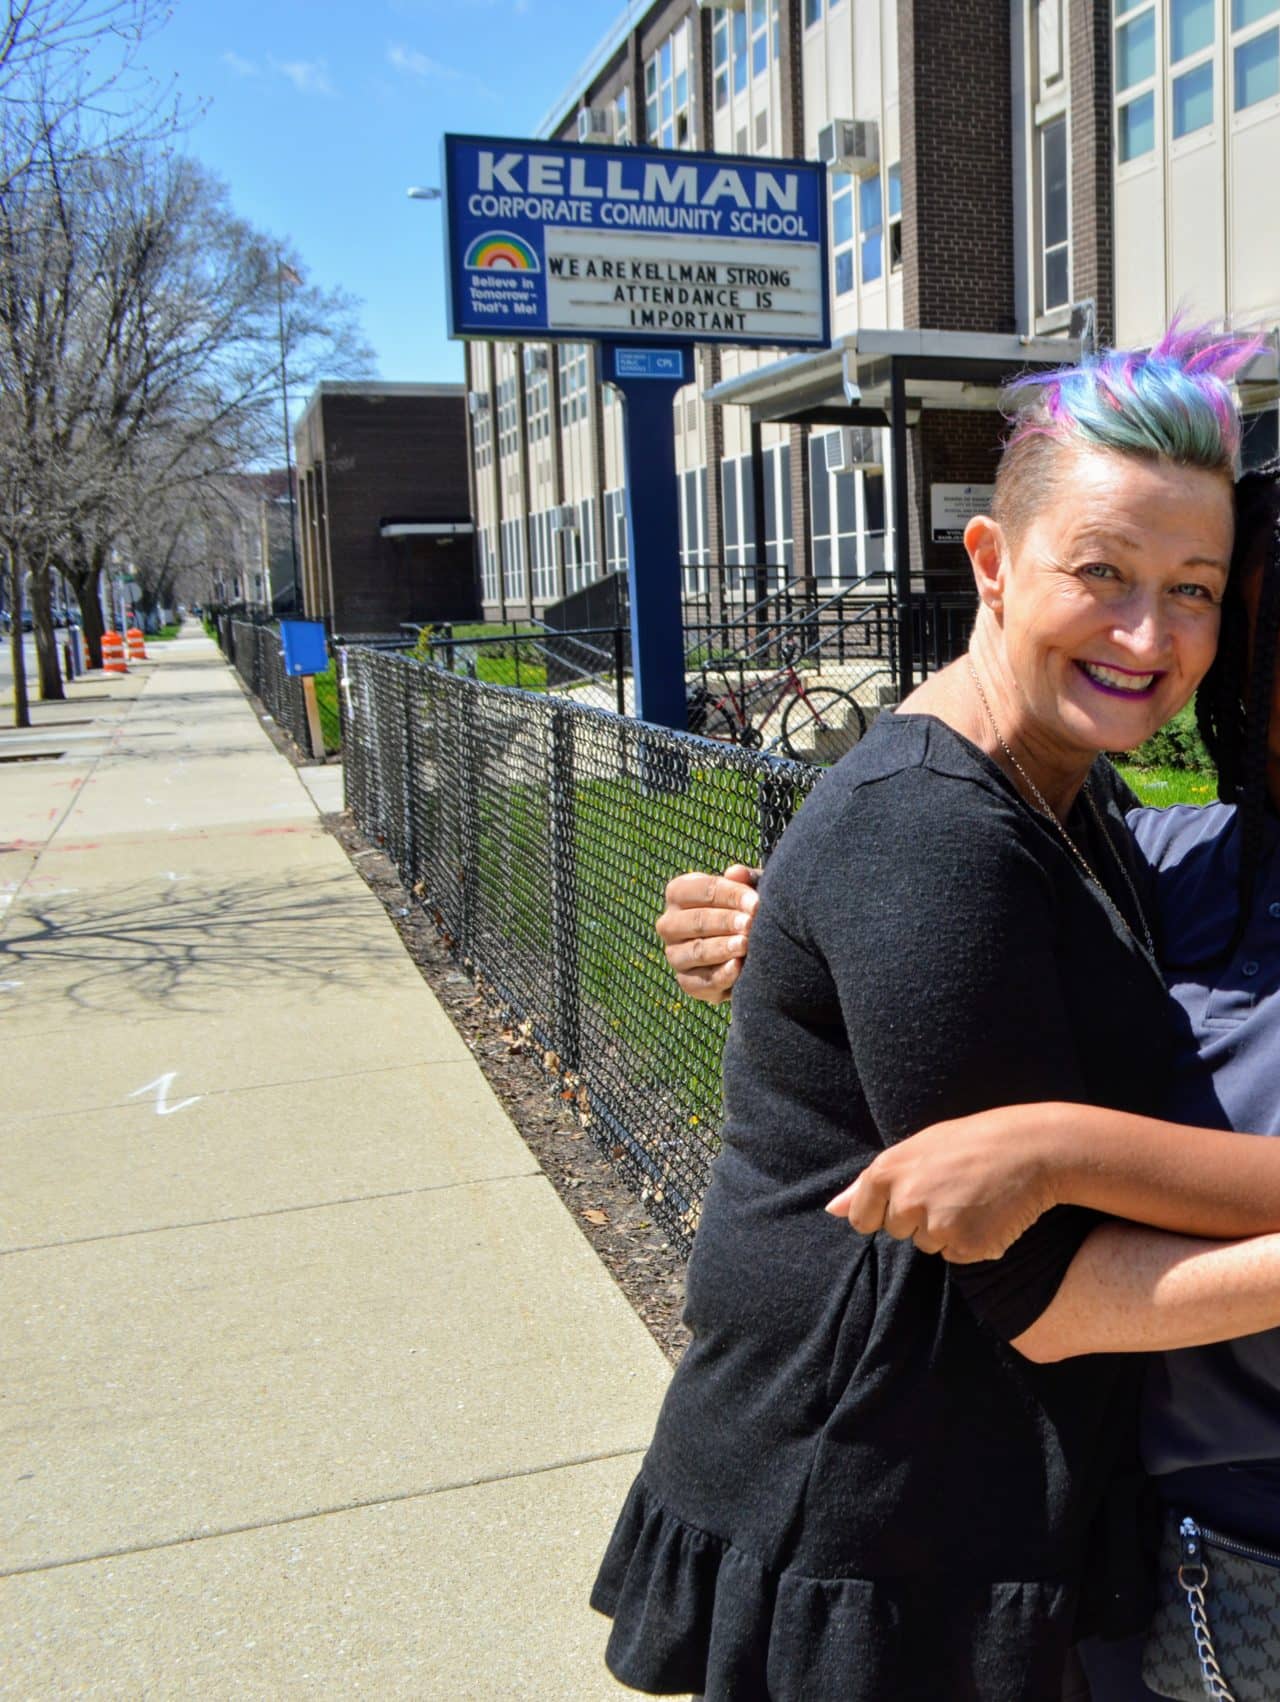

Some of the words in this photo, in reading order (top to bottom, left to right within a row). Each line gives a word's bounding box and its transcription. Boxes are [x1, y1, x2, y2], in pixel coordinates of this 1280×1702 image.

[478, 151, 799, 212] KELLMAN
[468, 194, 593, 223] CORPORATE
[600, 202, 722, 231] COMMUNITY
[730, 211, 808, 237] SCHOOL
[472, 275, 517, 289] Believe
[631, 261, 717, 284] KELLMAN
[727, 267, 791, 287] STRONG
[614, 285, 739, 308] ATTENDANCE
[756, 291, 772, 308] IS
[630, 308, 747, 330] IMPORTANT
